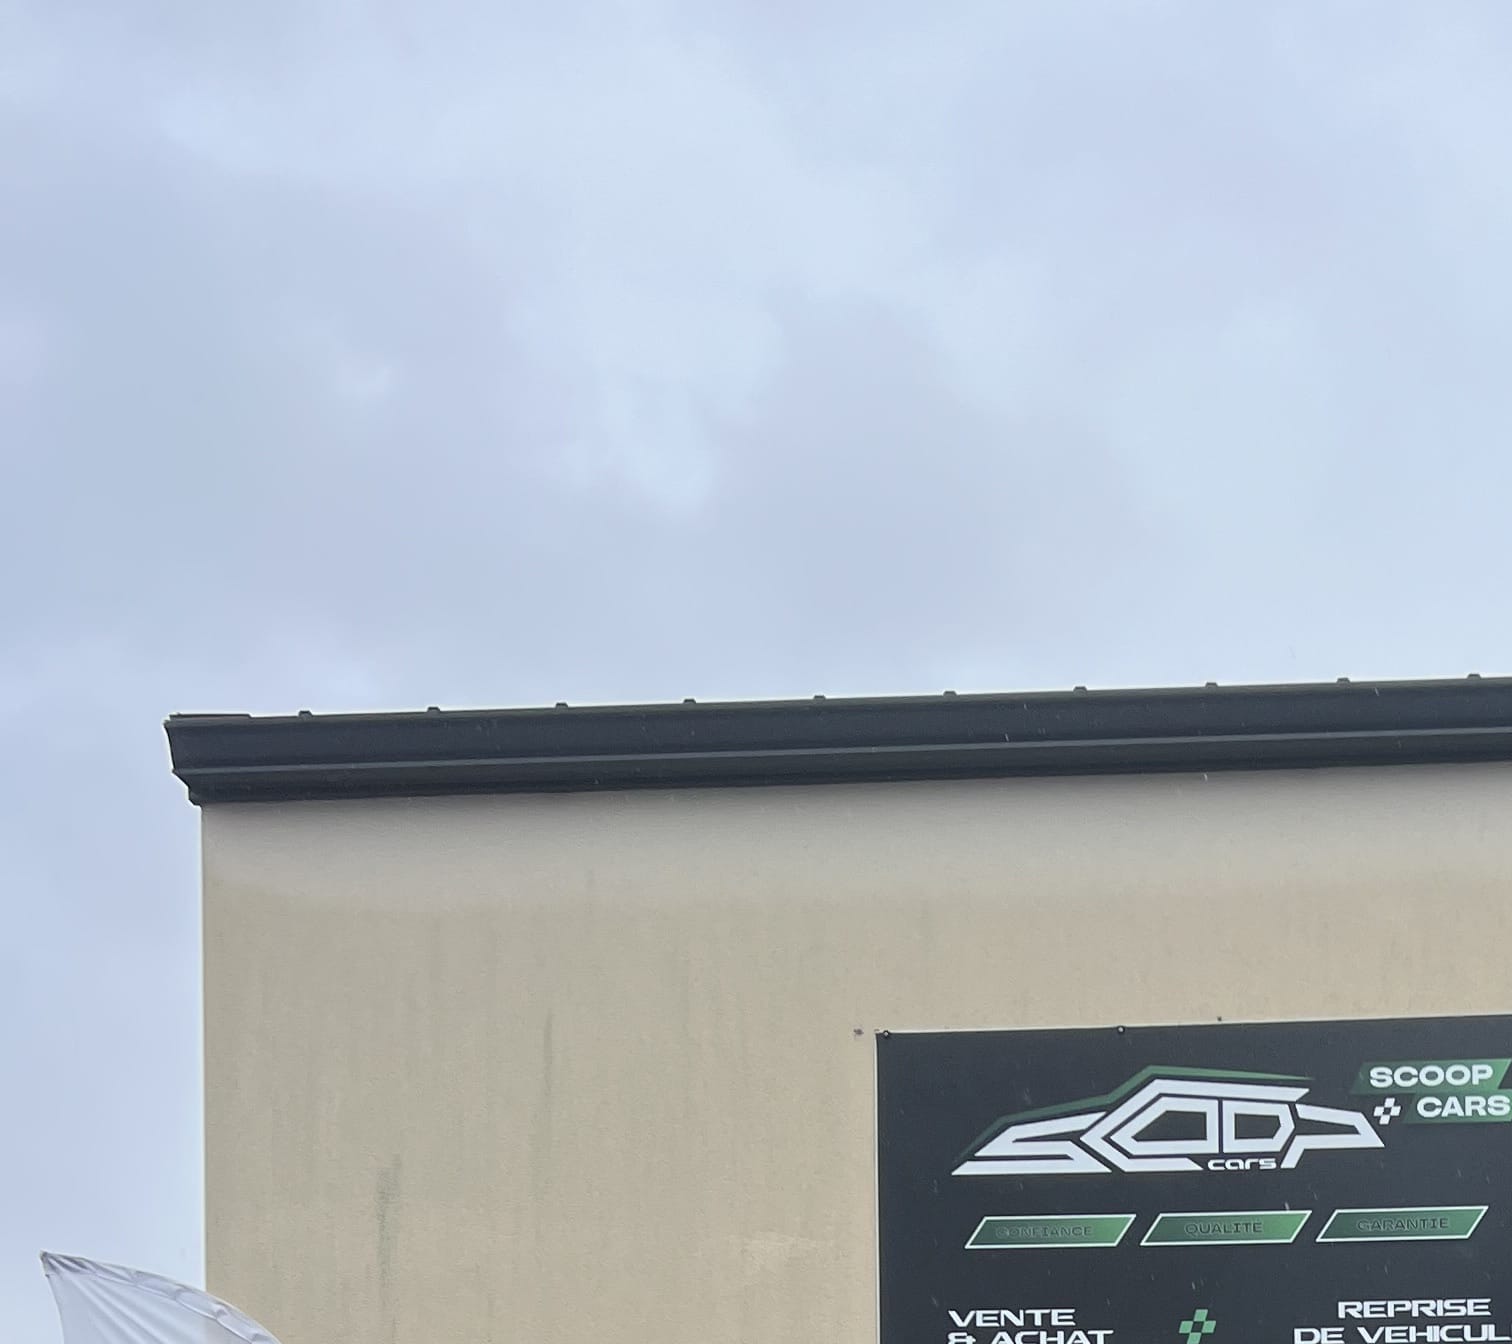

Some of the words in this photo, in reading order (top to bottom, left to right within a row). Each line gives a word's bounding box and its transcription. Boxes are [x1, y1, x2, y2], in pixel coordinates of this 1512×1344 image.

[1369, 1064, 1493, 1088] SCOOP
[1416, 1095, 1511, 1118] CARS
[1206, 1156, 1278, 1171] cars
[997, 1224, 1094, 1238] CONFIANCE
[1357, 1217, 1449, 1232] GARANTIE
[948, 1308, 1076, 1328] VENTE
[1337, 1298, 1492, 1319] REPRISE
